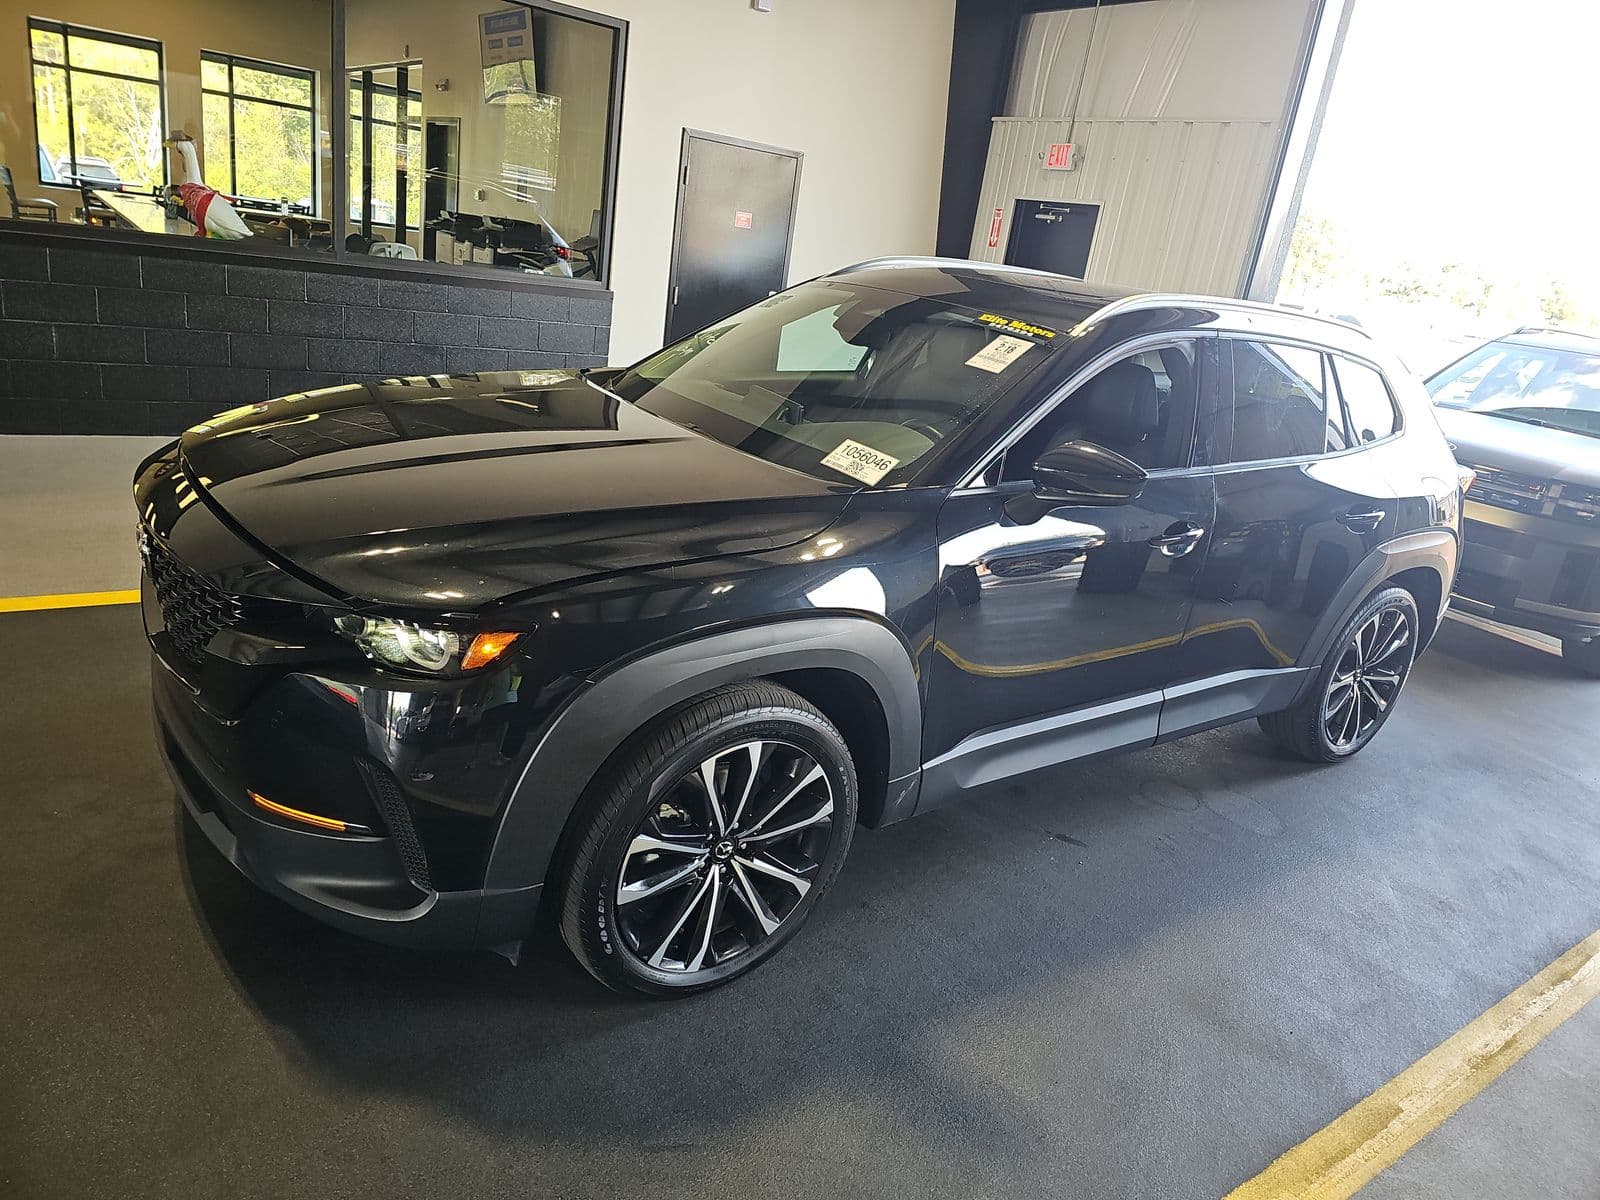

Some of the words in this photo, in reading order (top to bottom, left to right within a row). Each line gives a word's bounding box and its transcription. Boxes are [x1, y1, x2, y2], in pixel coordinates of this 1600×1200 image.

[1047, 144, 1071, 166] EXIT
[978, 313, 1008, 325] Elite
[1009, 320, 1057, 338] Motors
[841, 444, 892, 471] 1056046
